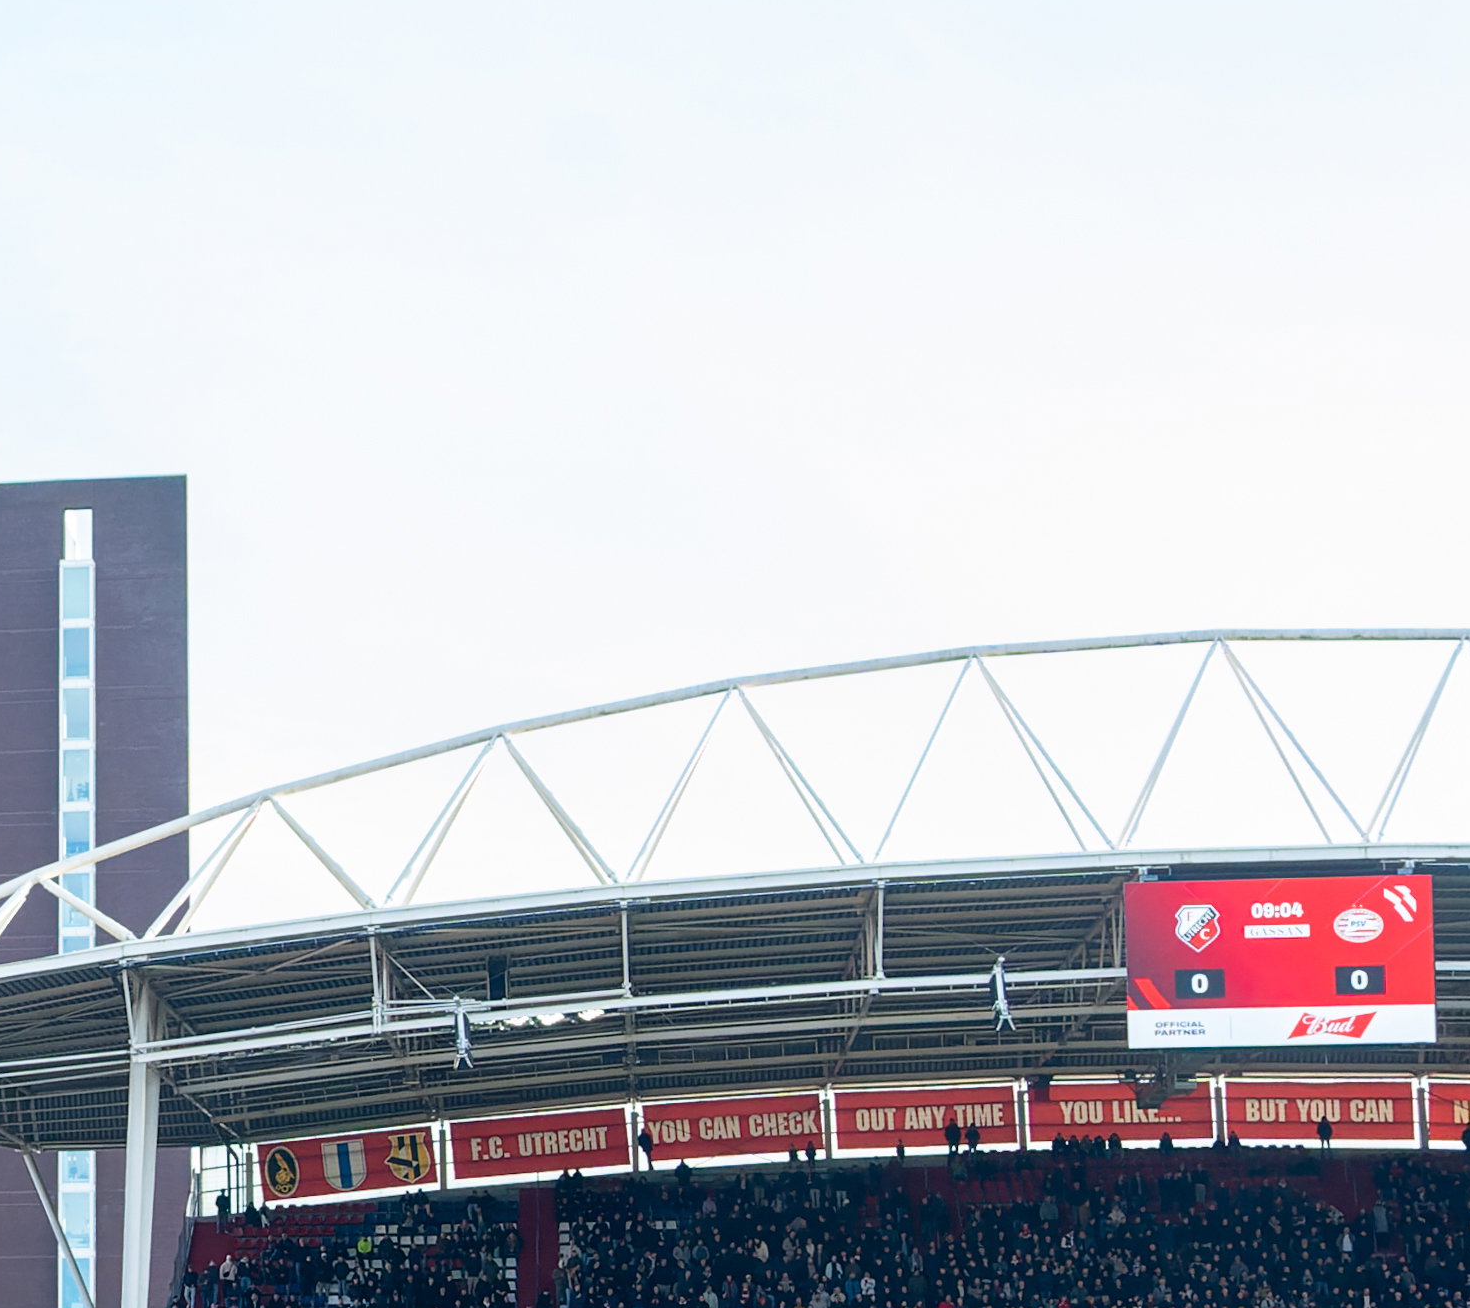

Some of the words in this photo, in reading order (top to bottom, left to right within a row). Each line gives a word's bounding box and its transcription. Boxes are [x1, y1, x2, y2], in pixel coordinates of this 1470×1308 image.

[1251, 902, 1304, 919] 09:04
[1182, 908, 1218, 941] UTRECHT
[1199, 928, 1211, 940] C
[1249, 926, 1305, 938] GASSAN
[1350, 920, 1366, 928] PSV
[1191, 973, 1209, 994] 0
[1350, 969, 1369, 990] 0
[1154, 1029, 1206, 1037] PARTNER
[1155, 1021, 1205, 1029] OFFICIAL
[1303, 1014, 1355, 1034] Bud
[855, 1107, 897, 1132] OUT
[904, 1105, 946, 1130] ANY
[953, 1103, 1004, 1128] TIME
[1060, 1100, 1104, 1124] YOU
[1245, 1098, 1288, 1123] BUT
[1296, 1098, 1341, 1123] YOU
[1350, 1099, 1394, 1123] CAN
[649, 1120, 690, 1145] YOU
[699, 1115, 741, 1140] CAN
[749, 1109, 819, 1137] CHECK
[471, 1136, 510, 1161] F.C.
[518, 1126, 608, 1157] UTRECHT
